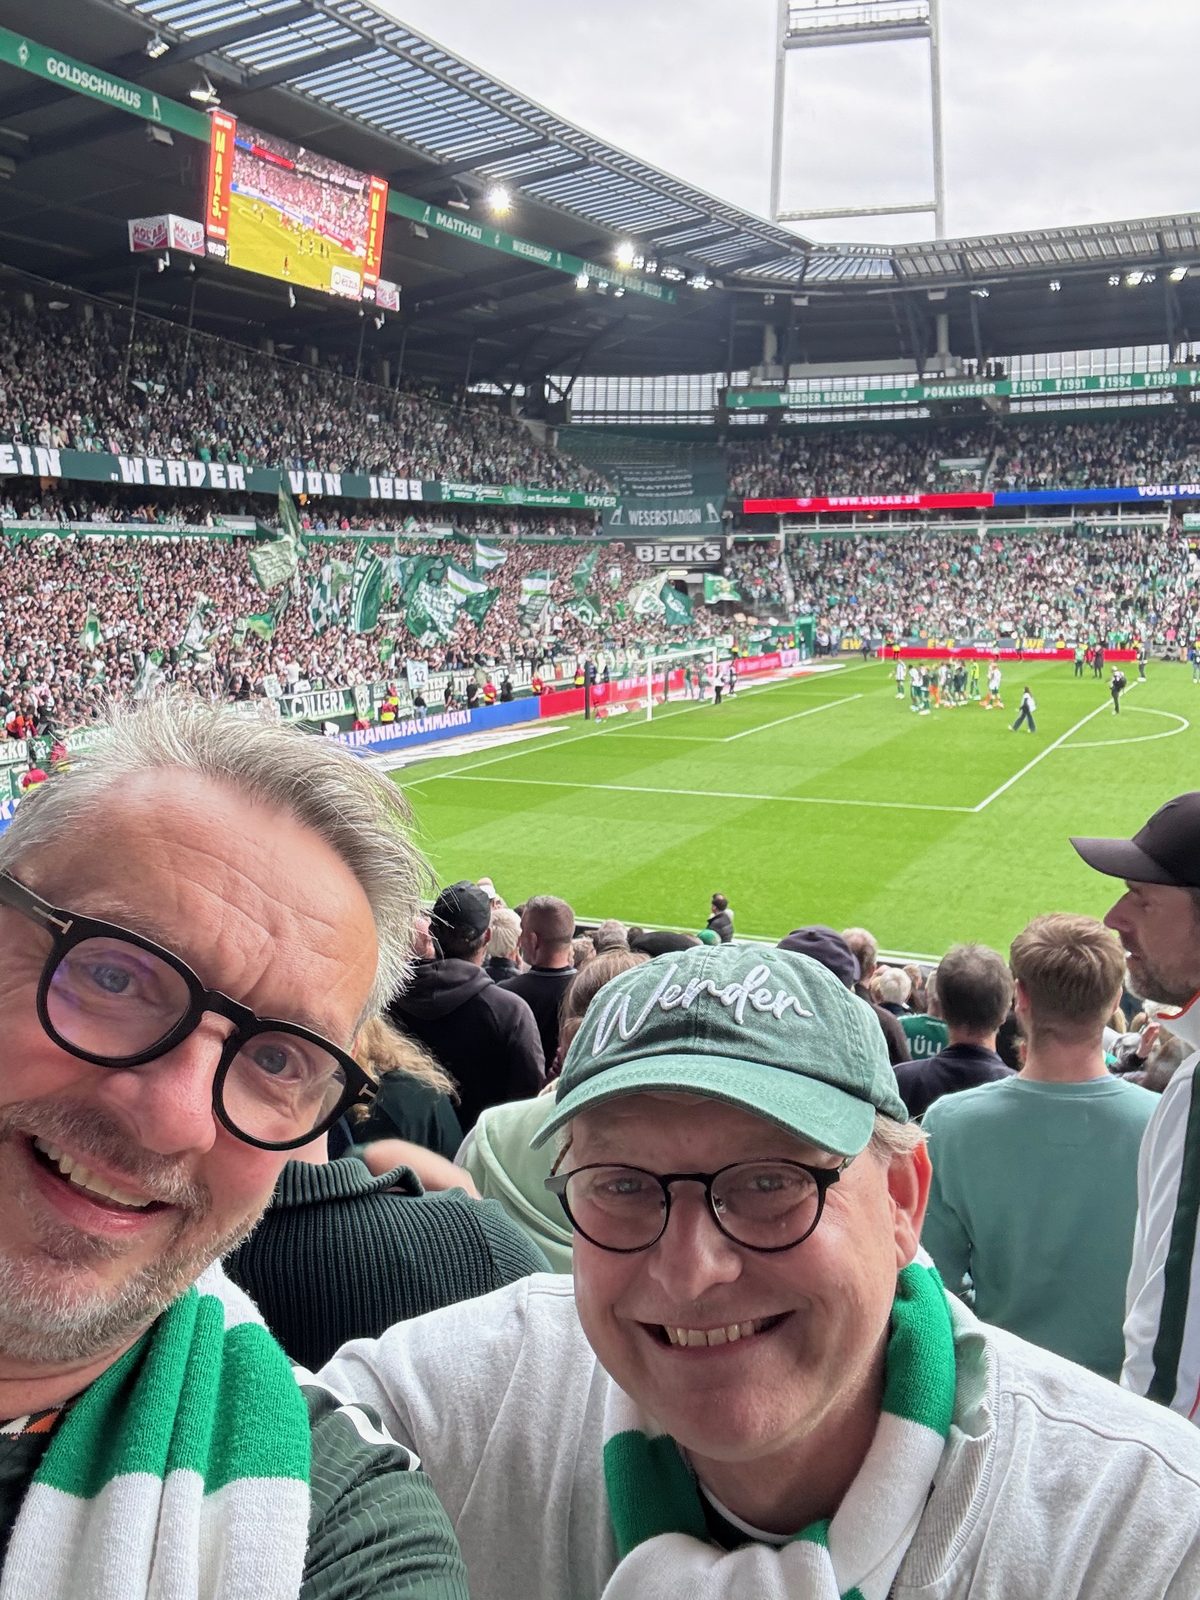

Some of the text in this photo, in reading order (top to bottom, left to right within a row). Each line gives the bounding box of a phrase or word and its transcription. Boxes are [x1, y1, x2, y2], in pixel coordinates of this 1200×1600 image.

[47, 57, 141, 109] GOLDSCHMAUS
[924, 372, 1178, 398] POKALSIEGER 1961 1991 1994 1999
[779, 391, 865, 405] WERDER BREMEN
[0, 444, 62, 477] EIN
[288, 470, 342, 496] VON
[369, 476, 423, 500] 1899
[1138, 485, 1177, 497] VOLLE
[584, 495, 617, 508] HOYER
[628, 508, 702, 526] WESERSTADION
[635, 542, 722, 562] BECK'S
[592, 963, 815, 1057] Werder
